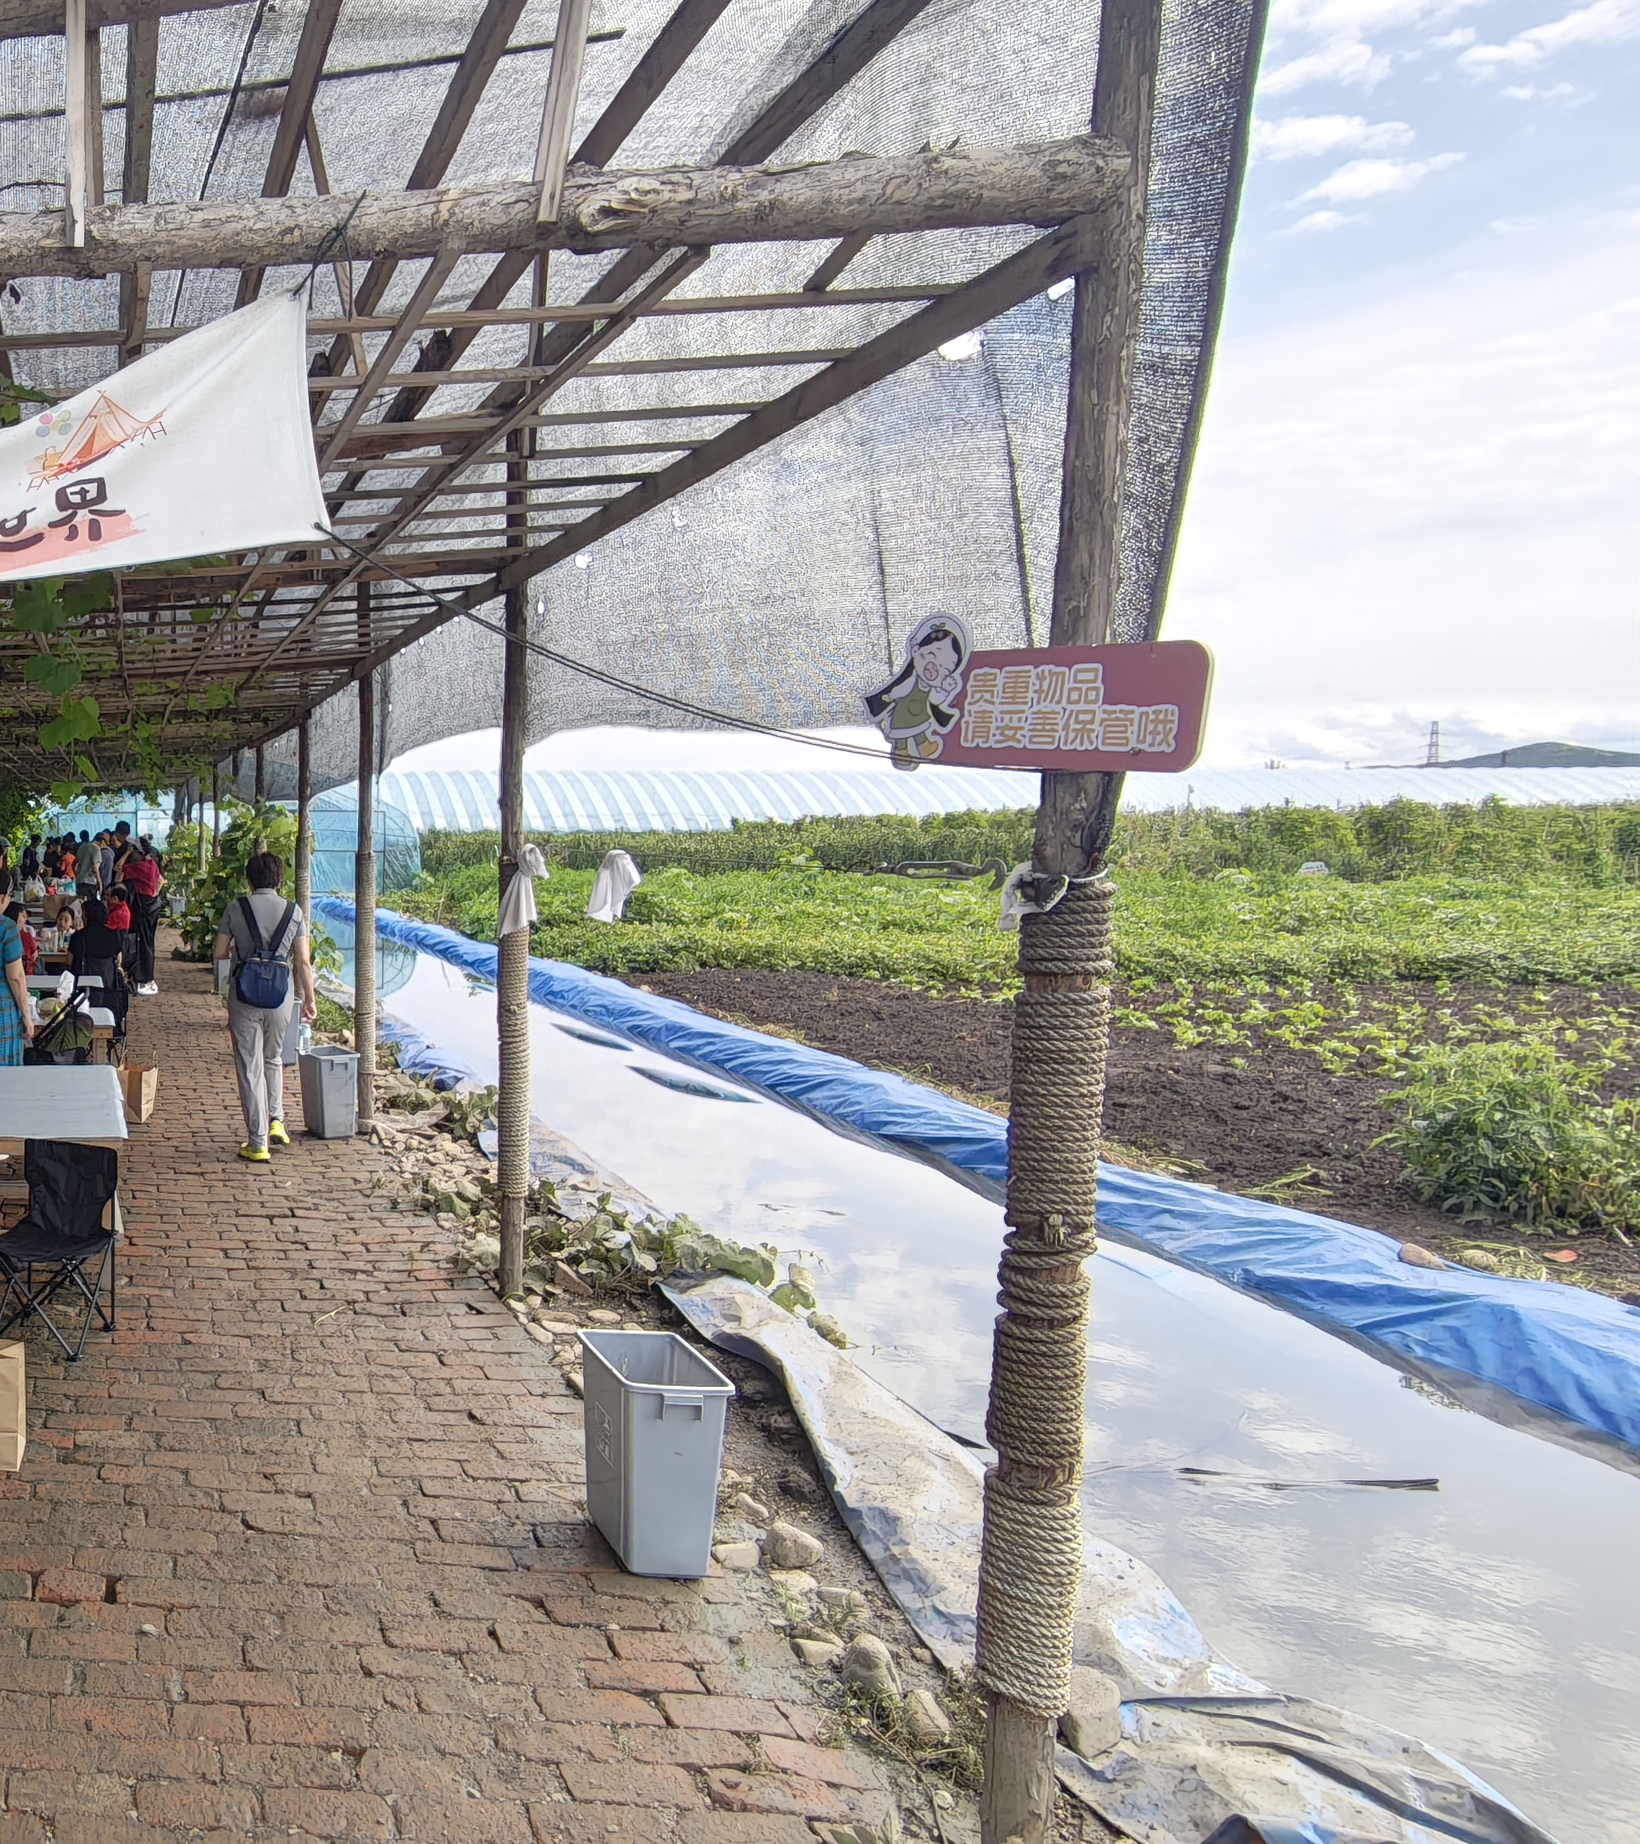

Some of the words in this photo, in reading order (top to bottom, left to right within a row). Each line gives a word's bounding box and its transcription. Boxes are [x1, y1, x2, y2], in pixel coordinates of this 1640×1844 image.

[965, 664, 1104, 707] 贵重物品
[961, 704, 1178, 751] 请妥善保管哦
